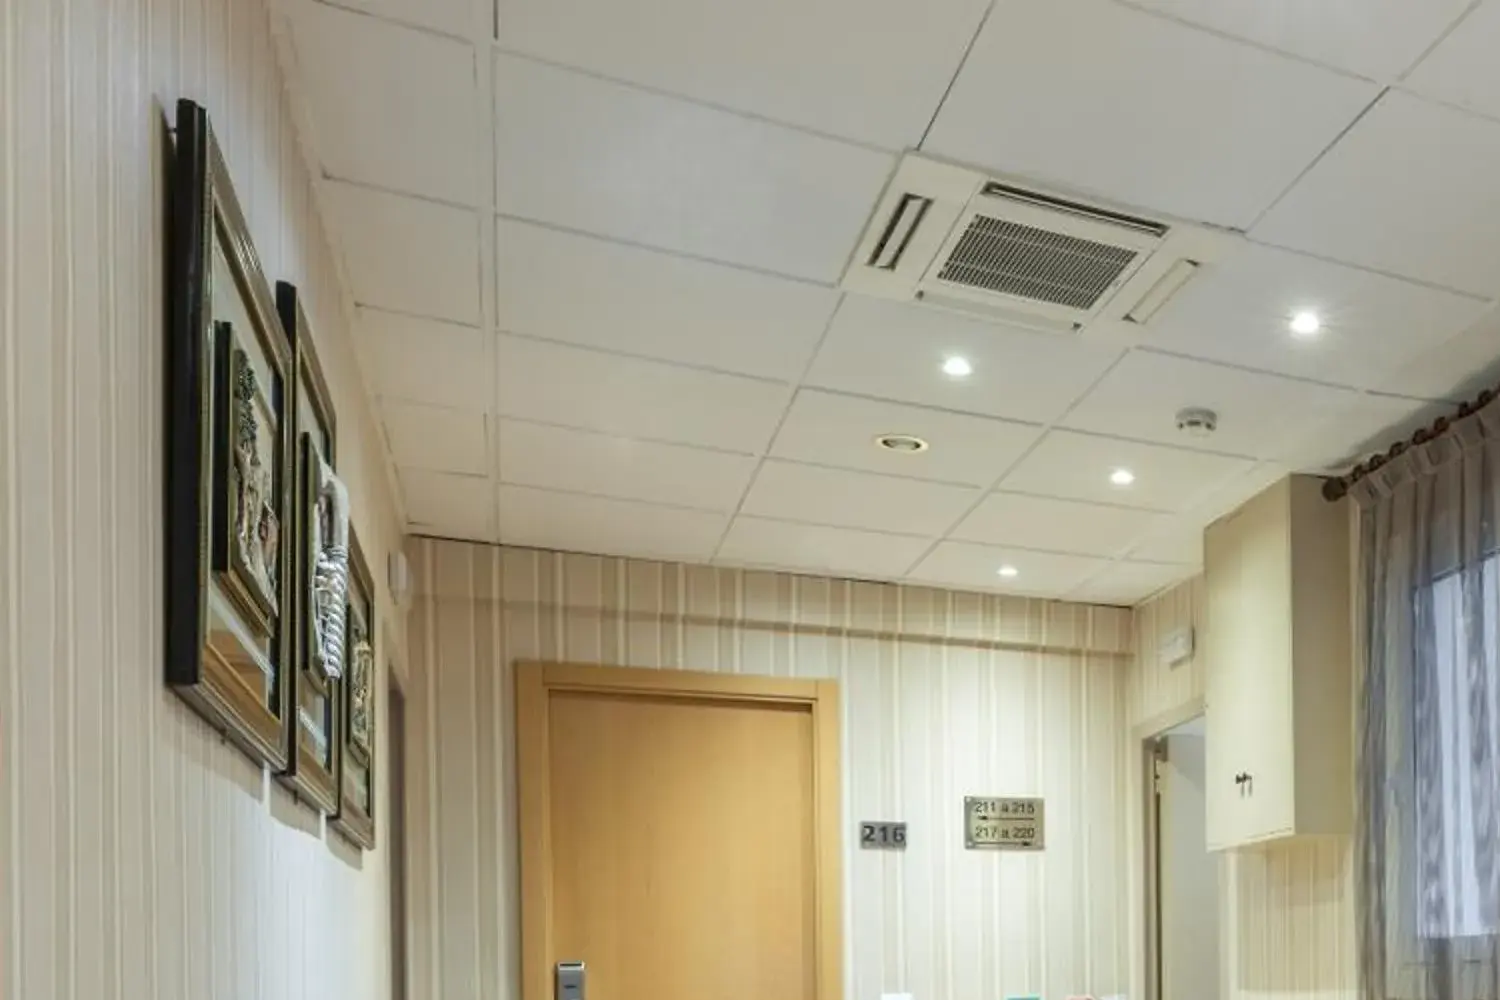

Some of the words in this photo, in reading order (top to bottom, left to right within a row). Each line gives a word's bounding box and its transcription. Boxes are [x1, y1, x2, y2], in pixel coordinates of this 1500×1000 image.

[975, 801, 996, 813] 211
[1011, 801, 1035, 814] 215
[862, 825, 906, 843] 216
[975, 826, 998, 839] 217
[1012, 827, 1035, 839] 220
